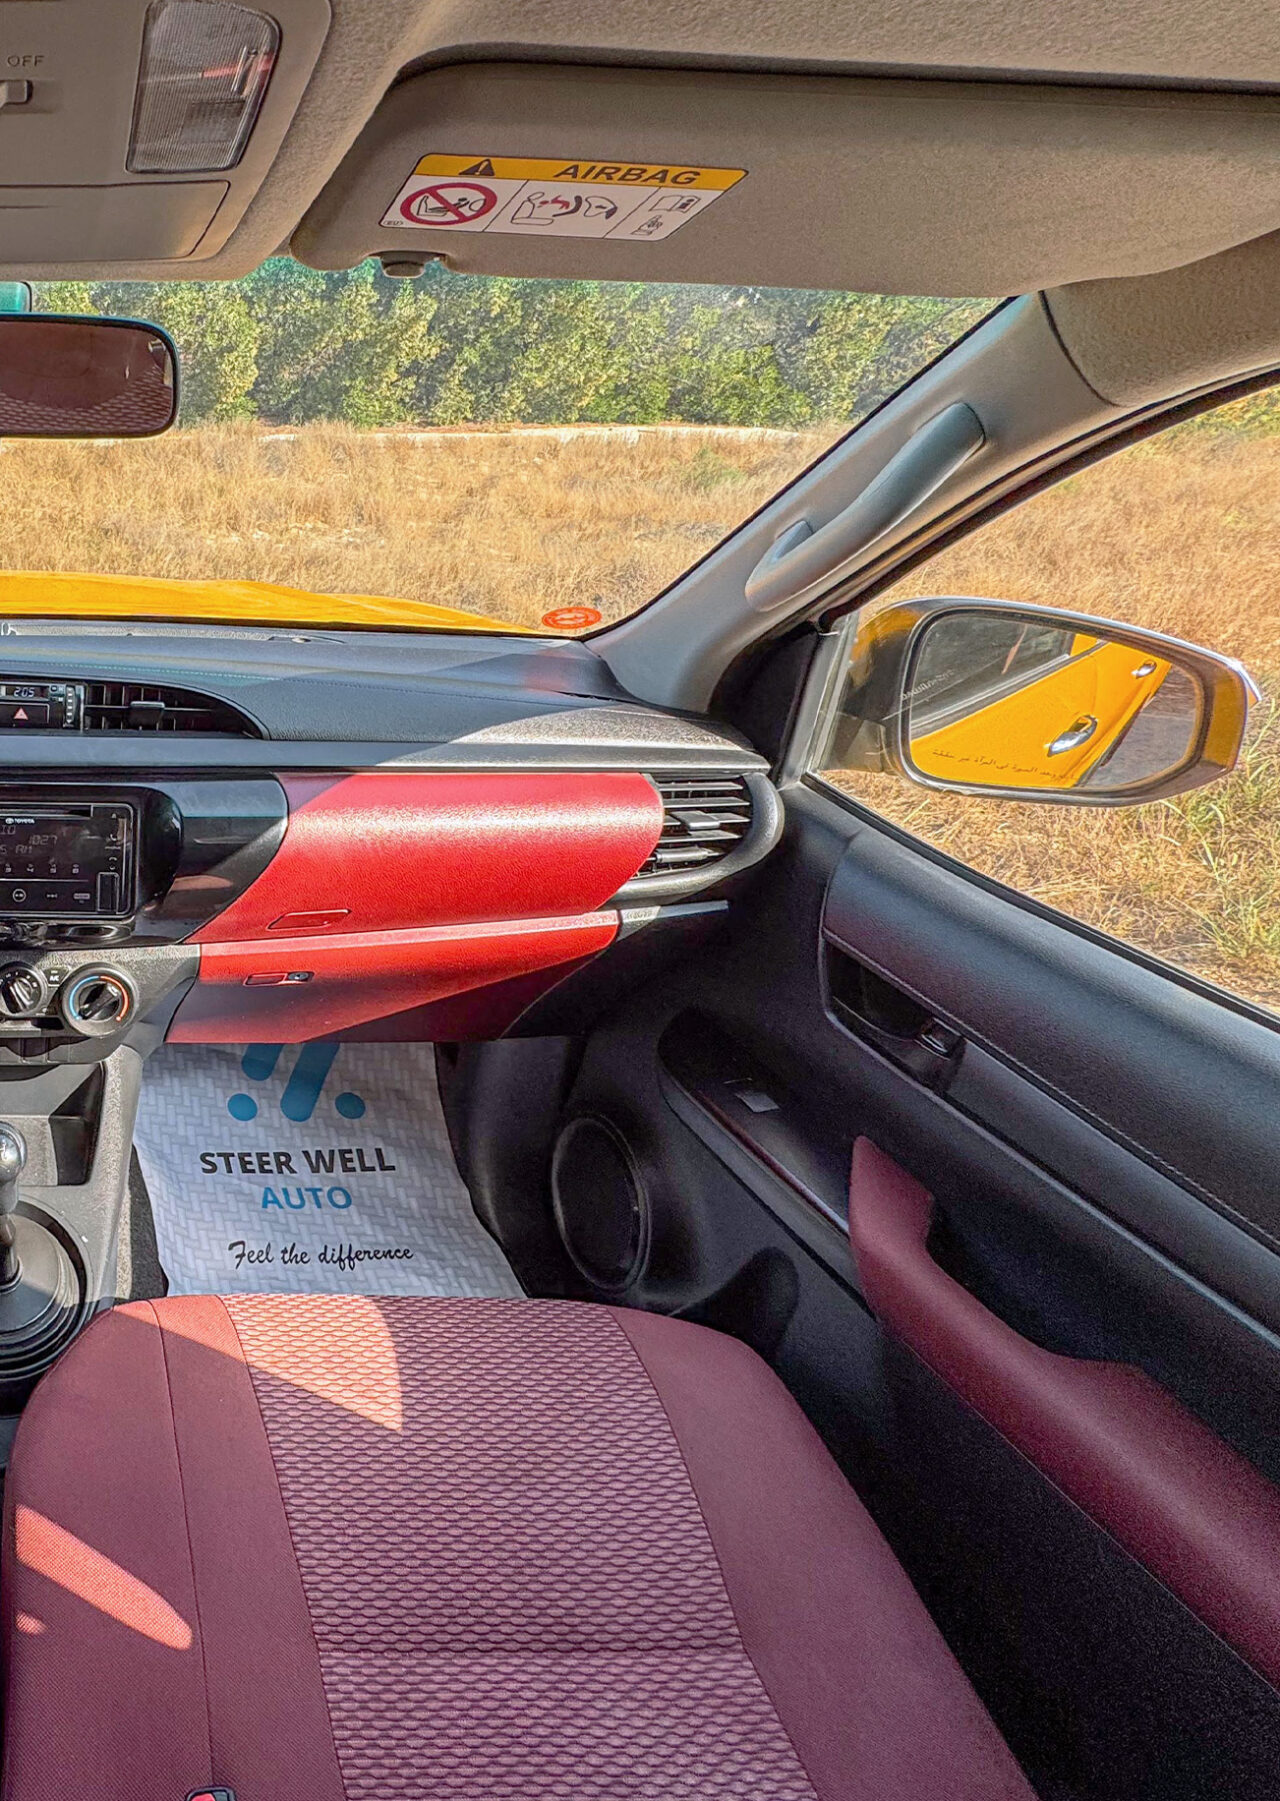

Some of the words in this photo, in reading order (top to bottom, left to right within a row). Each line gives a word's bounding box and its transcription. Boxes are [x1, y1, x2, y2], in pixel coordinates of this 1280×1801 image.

[6, 54, 45, 67] OFF
[553, 163, 702, 186] AIRBAG
[199, 1151, 297, 1174] STEER
[302, 1147, 396, 1174] WELL
[261, 1186, 353, 1210] AUTO
[228, 1240, 274, 1270] Feel
[280, 1242, 311, 1265] the
[317, 1243, 414, 1272] difference
